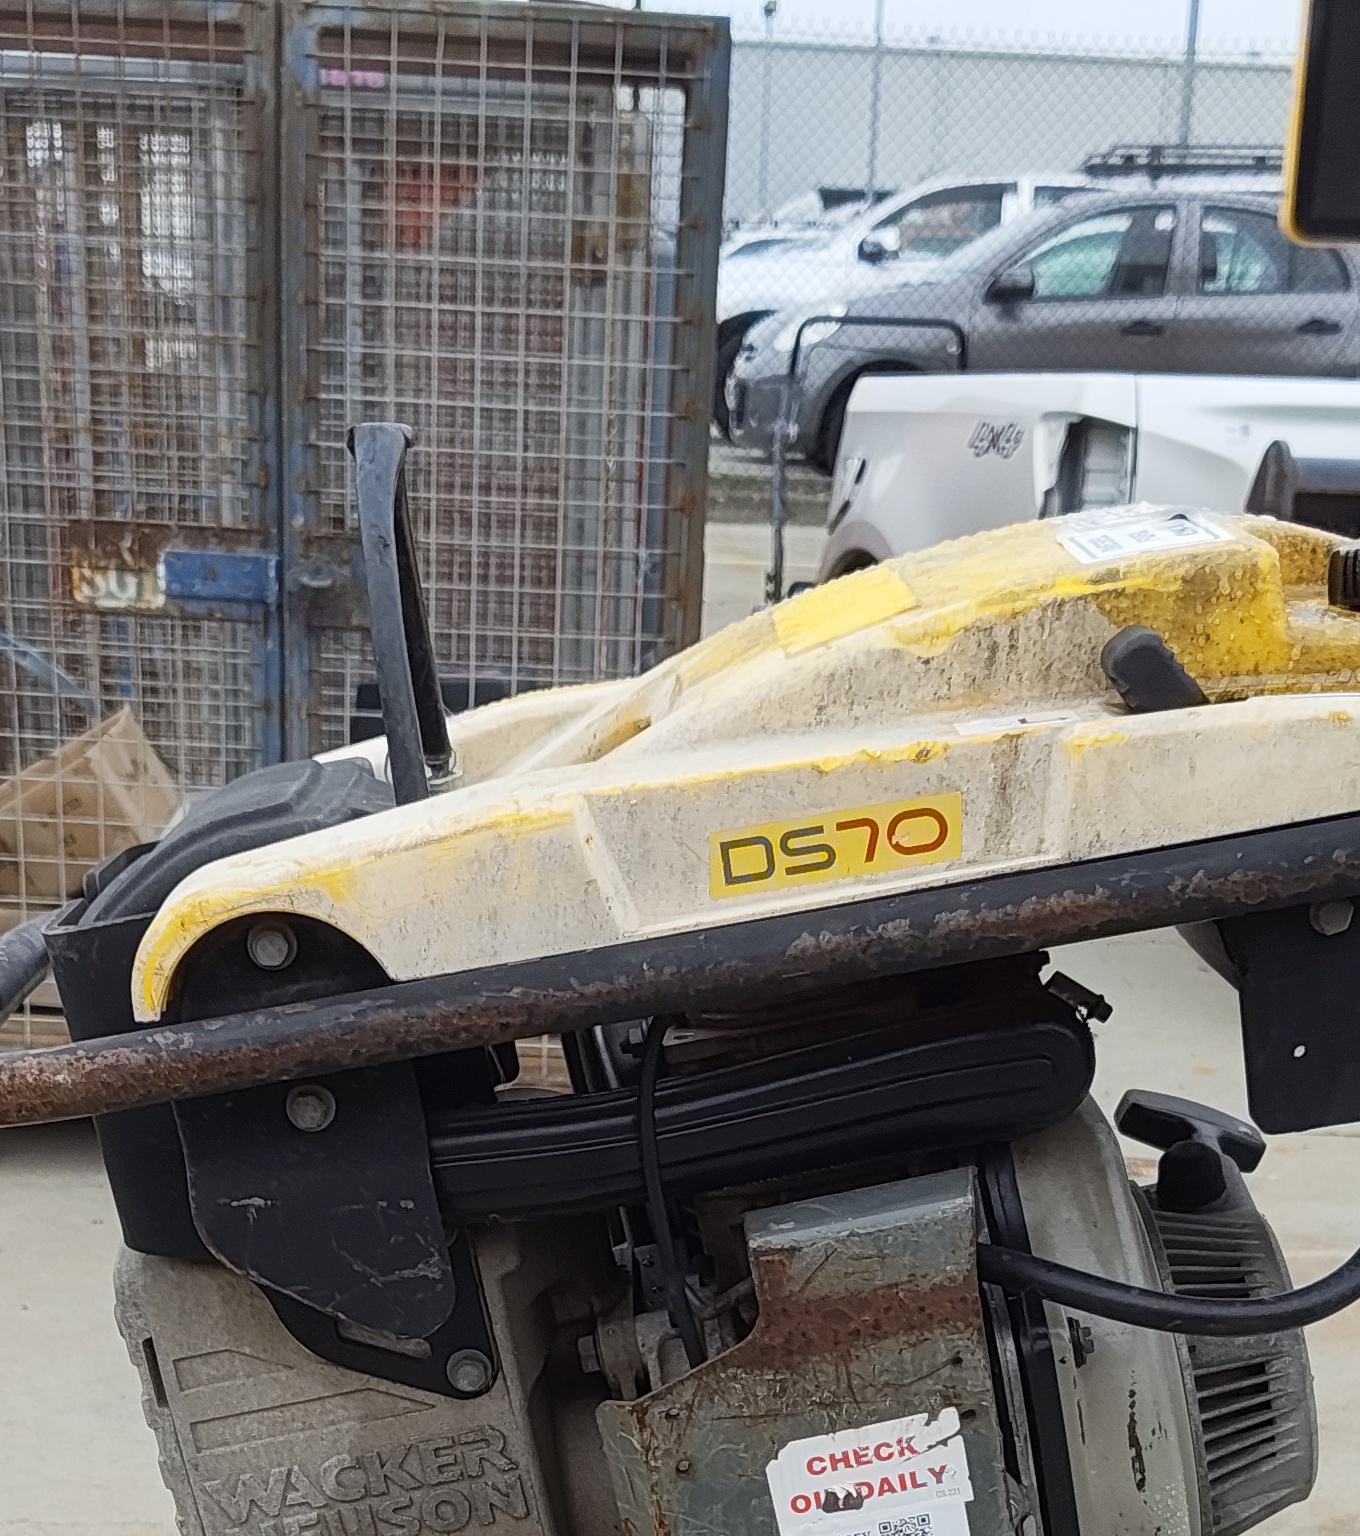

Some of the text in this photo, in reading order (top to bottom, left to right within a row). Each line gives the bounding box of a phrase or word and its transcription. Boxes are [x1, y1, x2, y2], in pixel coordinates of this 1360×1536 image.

[719, 807, 948, 887] DS70
[203, 1425, 519, 1524] WACKER
[806, 1435, 920, 1476] CHECK
[853, 1464, 947, 1500] DAILY
